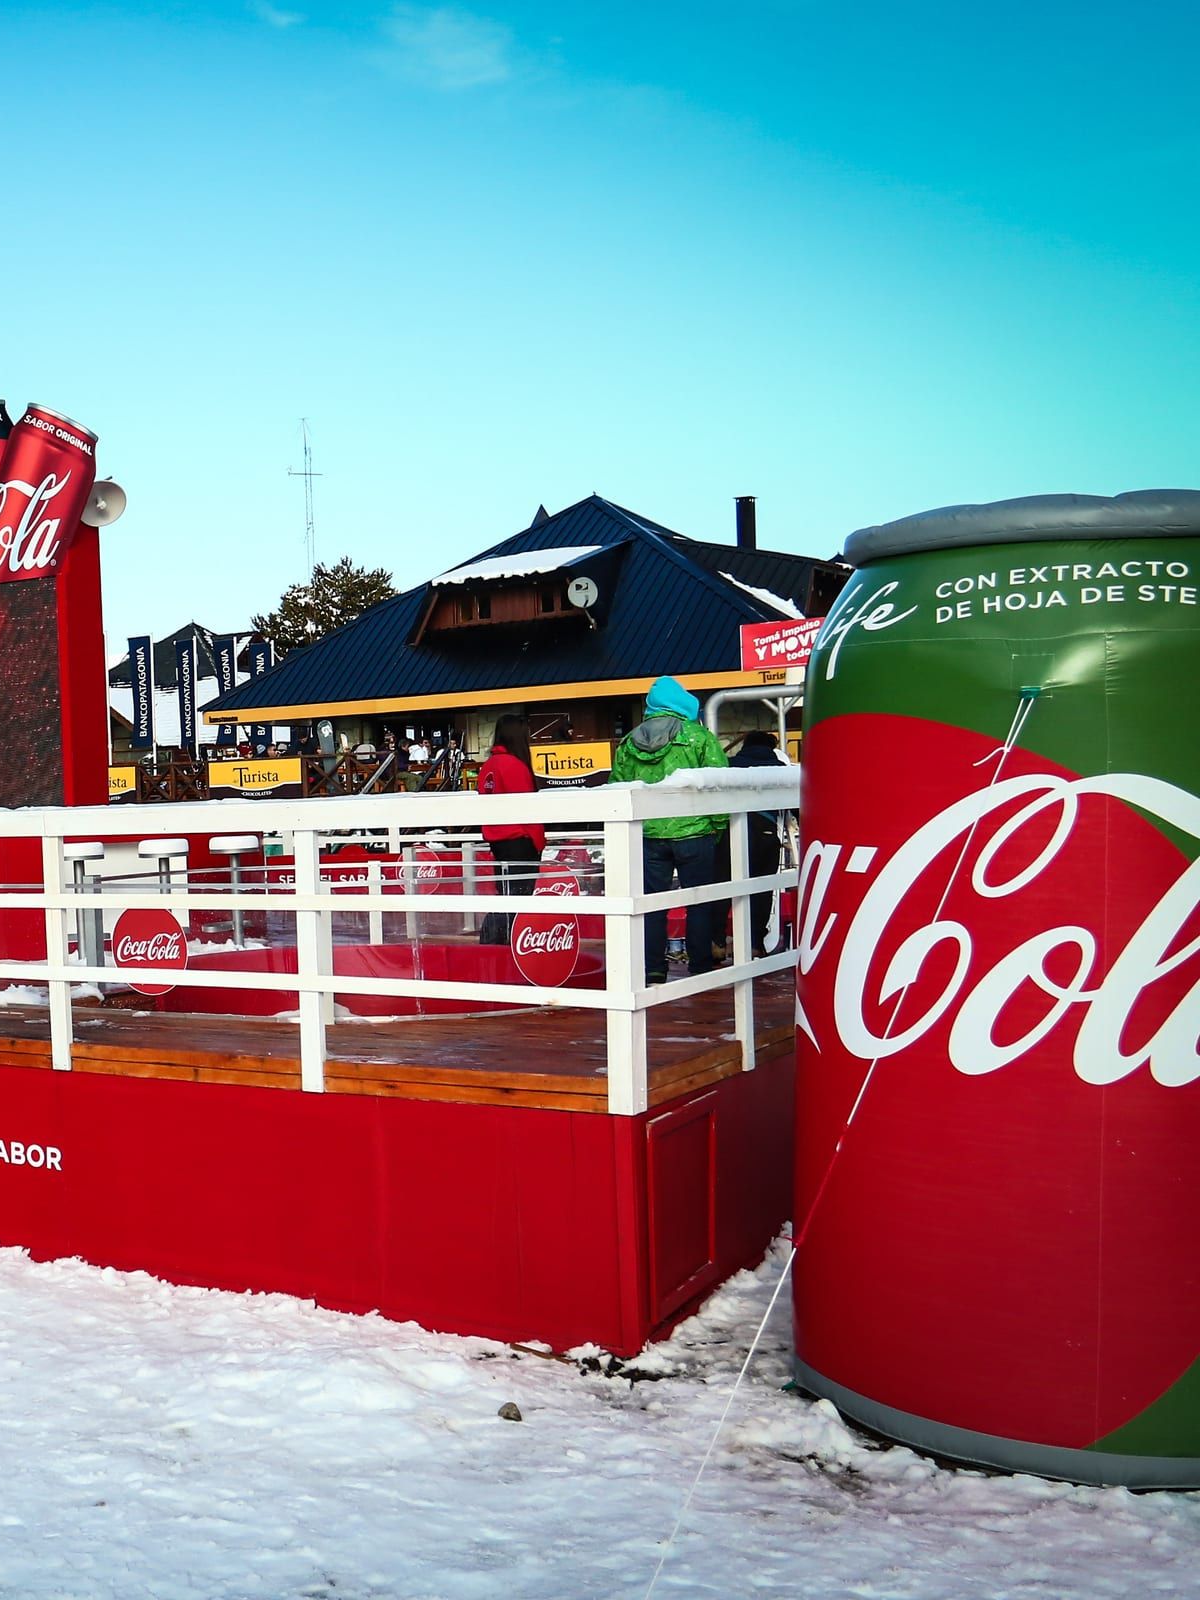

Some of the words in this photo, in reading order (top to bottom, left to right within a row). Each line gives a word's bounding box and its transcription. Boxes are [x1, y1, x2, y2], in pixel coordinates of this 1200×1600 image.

[23, 413, 56, 434] SABOR
[55, 427, 93, 456] ORIGINAL
[935, 571, 997, 600] CON
[1008, 560, 1189, 586] EXTRACTO
[936, 603, 973, 624] DE
[983, 590, 1068, 614] HOJA
[1080, 584, 1125, 605] DE
[752, 631, 781, 647] Tomá
[782, 620, 821, 639] impulso
[818, 581, 918, 681] life
[754, 646, 768, 661] Y
[786, 647, 812, 661] todo
[135, 646, 148, 738] BANCOPATAGONIA
[181, 649, 192, 738] BANCOPATAGONIA
[232, 767, 279, 787] Turista
[536, 752, 595, 775] Turista
[109, 777, 127, 789] ista
[116, 932, 182, 962] Coca-Cola
[516, 922, 576, 955] Coca-Cola
